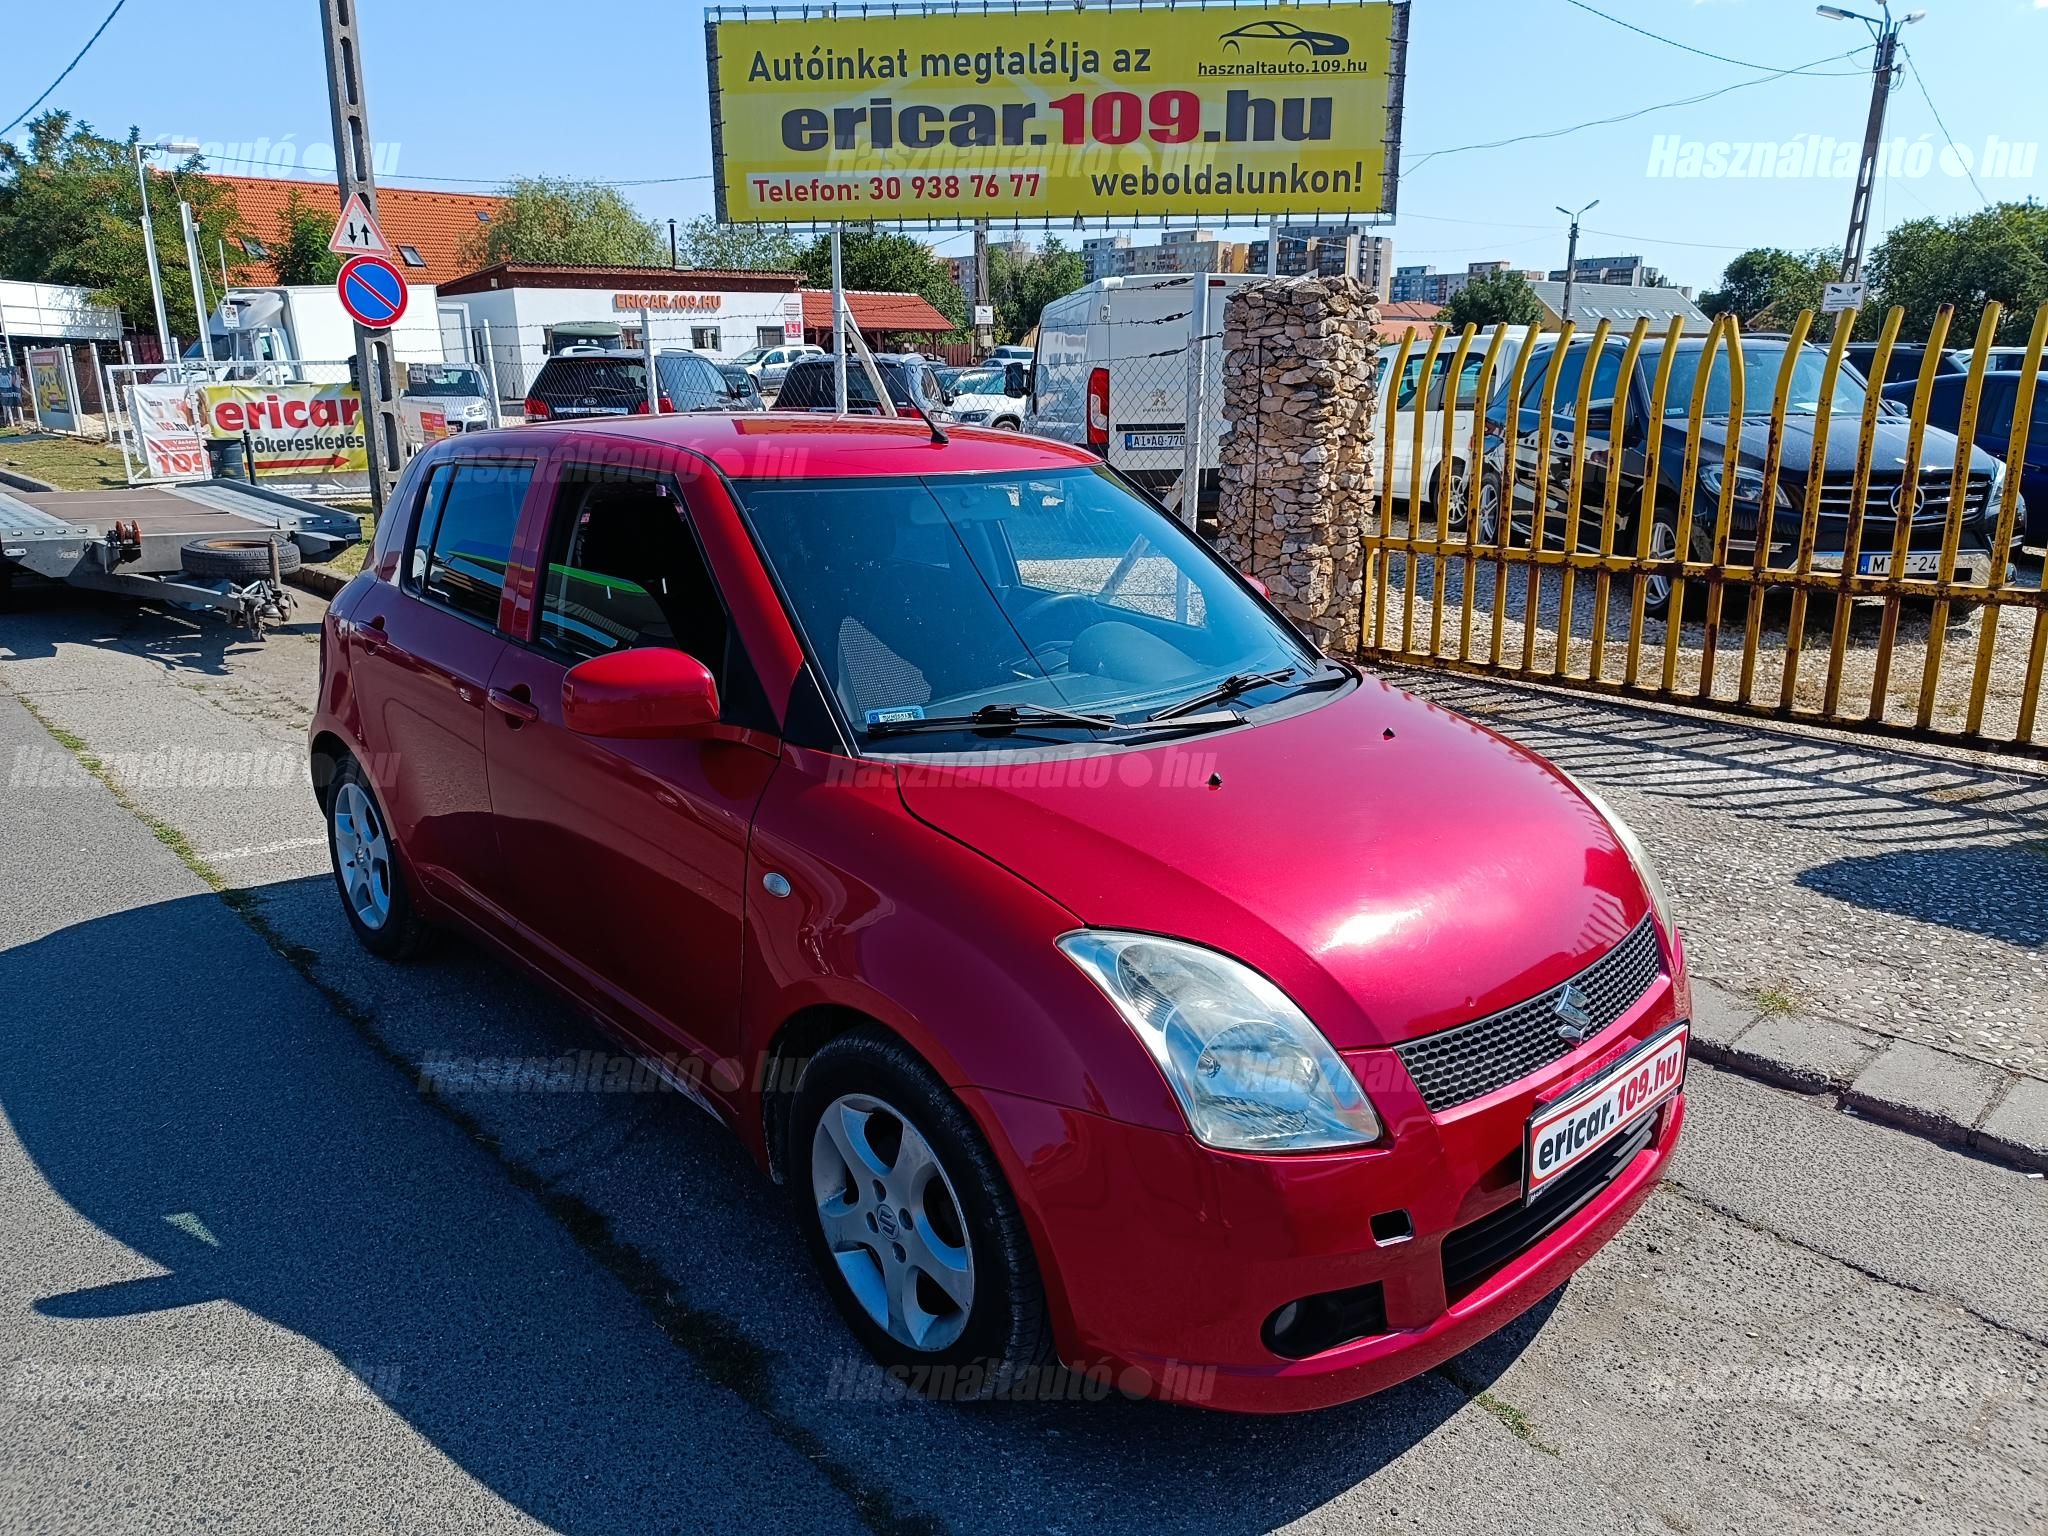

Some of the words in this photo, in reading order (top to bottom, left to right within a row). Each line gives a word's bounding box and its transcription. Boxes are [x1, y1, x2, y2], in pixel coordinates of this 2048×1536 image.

[748, 46, 908, 82] Autóinkat
[920, 39, 1101, 83] megtalálja
[1113, 48, 1151, 74] az
[1198, 58, 1368, 76] hasznaltauto.109.hu
[781, 89, 1333, 152] ericar.109.hu
[753, 179, 860, 202] Telefon:
[870, 177, 900, 200] 30
[911, 175, 960, 199] 938
[970, 174, 999, 198] 76
[1009, 173, 1040, 197] 77
[1091, 161, 1363, 197] weboldalunkon!
[614, 294, 721, 310] ERICAR.109.HU
[215, 395, 360, 431] ericar
[1538, 1050, 1679, 1171] ericar.109.hu
